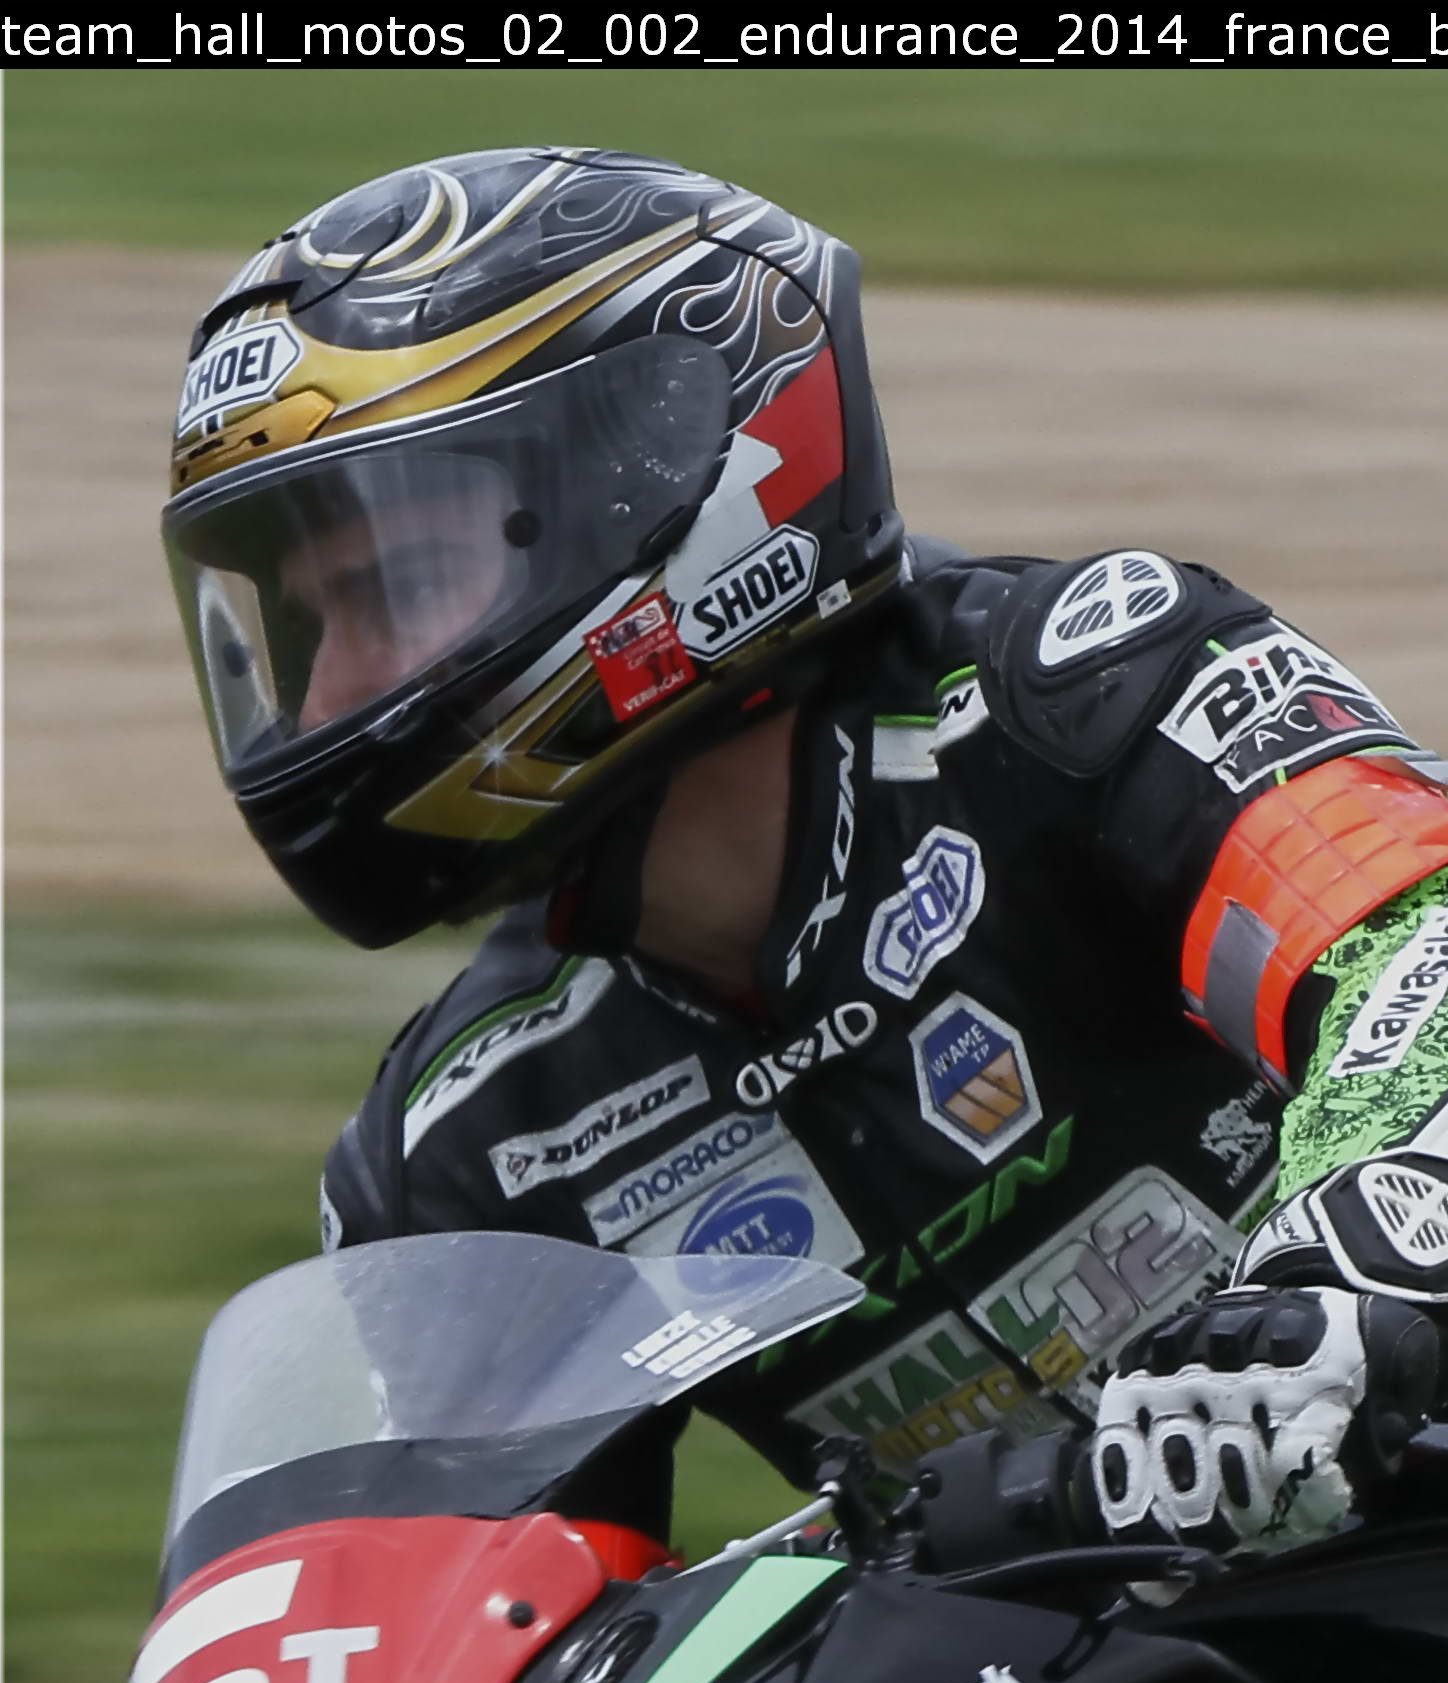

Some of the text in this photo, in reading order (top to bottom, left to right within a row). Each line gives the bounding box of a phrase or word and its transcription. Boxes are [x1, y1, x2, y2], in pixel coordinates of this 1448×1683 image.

[182, 336, 277, 416] SHOEI
[692, 540, 807, 643] SHOEI
[1175, 644, 1337, 743] Bihr
[541, 1074, 693, 1166] DUNLOP
[618, 1119, 754, 1219] MORACO
[703, 1211, 773, 1265] MTT
[824, 1295, 1062, 1442] HALL
